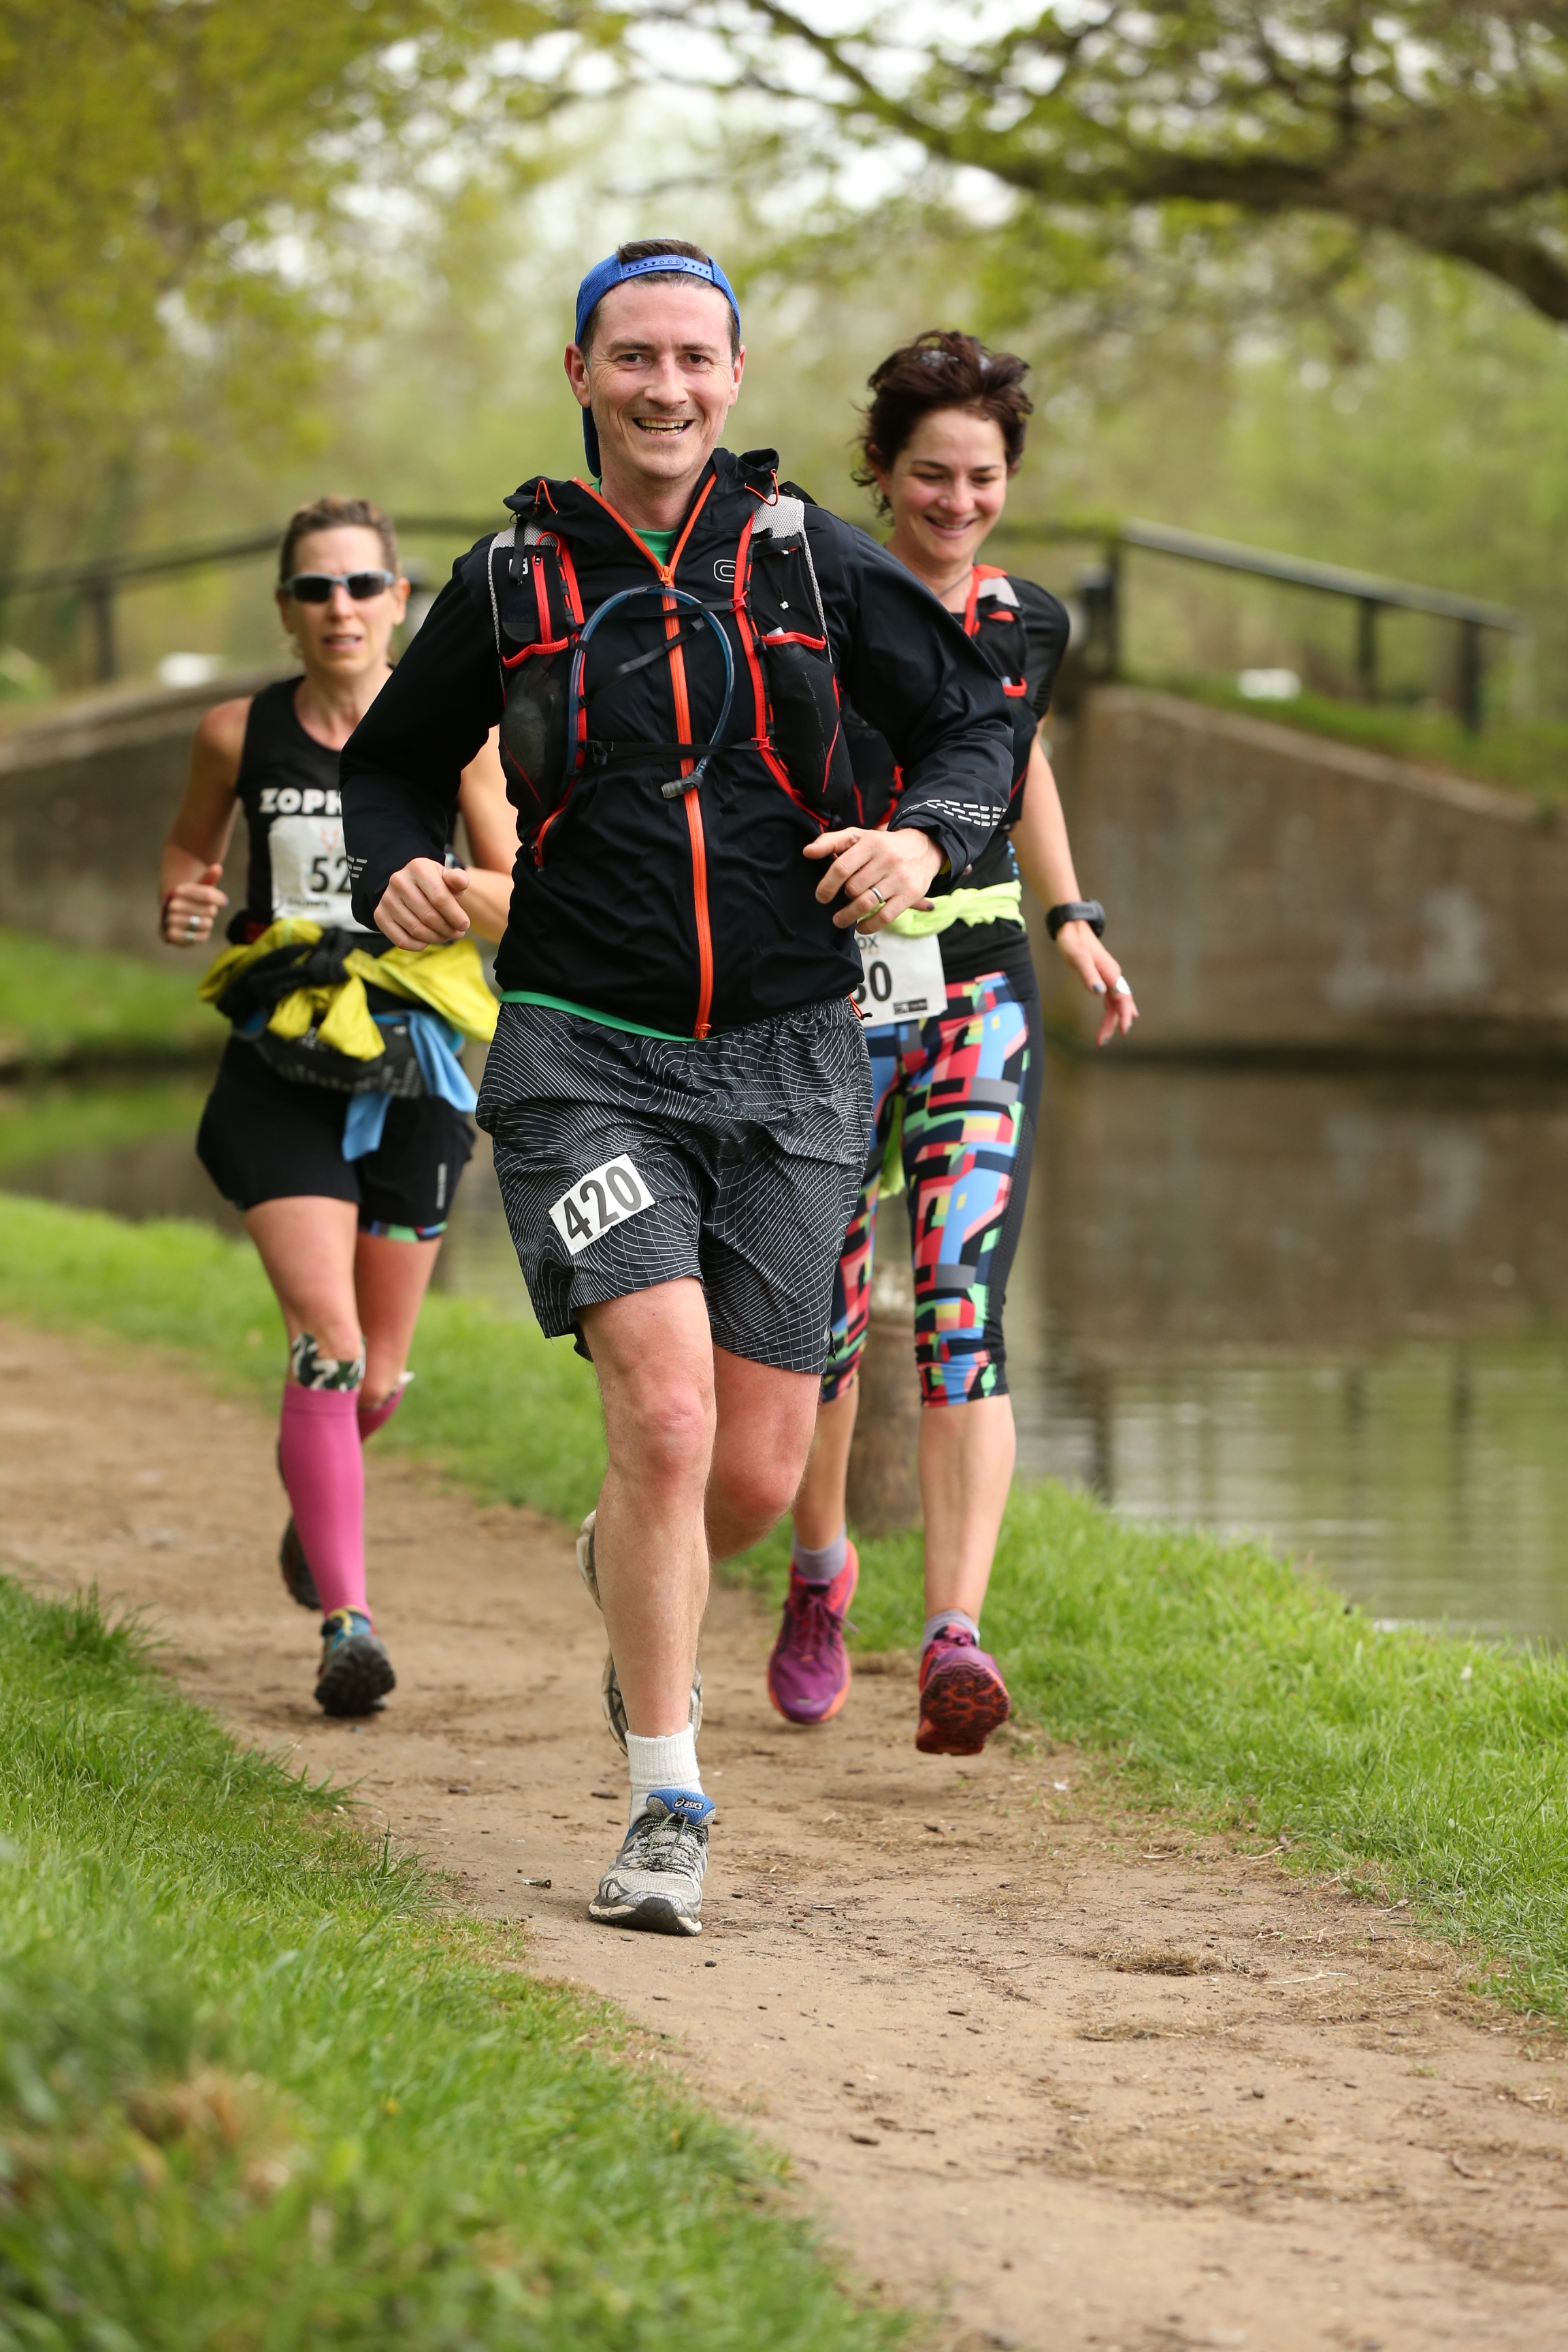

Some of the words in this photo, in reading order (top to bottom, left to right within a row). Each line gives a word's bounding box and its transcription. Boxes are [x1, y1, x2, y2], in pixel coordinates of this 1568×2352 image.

[508, 613, 535, 623] Vaselin
[259, 787, 342, 815] ZOPH
[564, 1166, 641, 1240] 420
